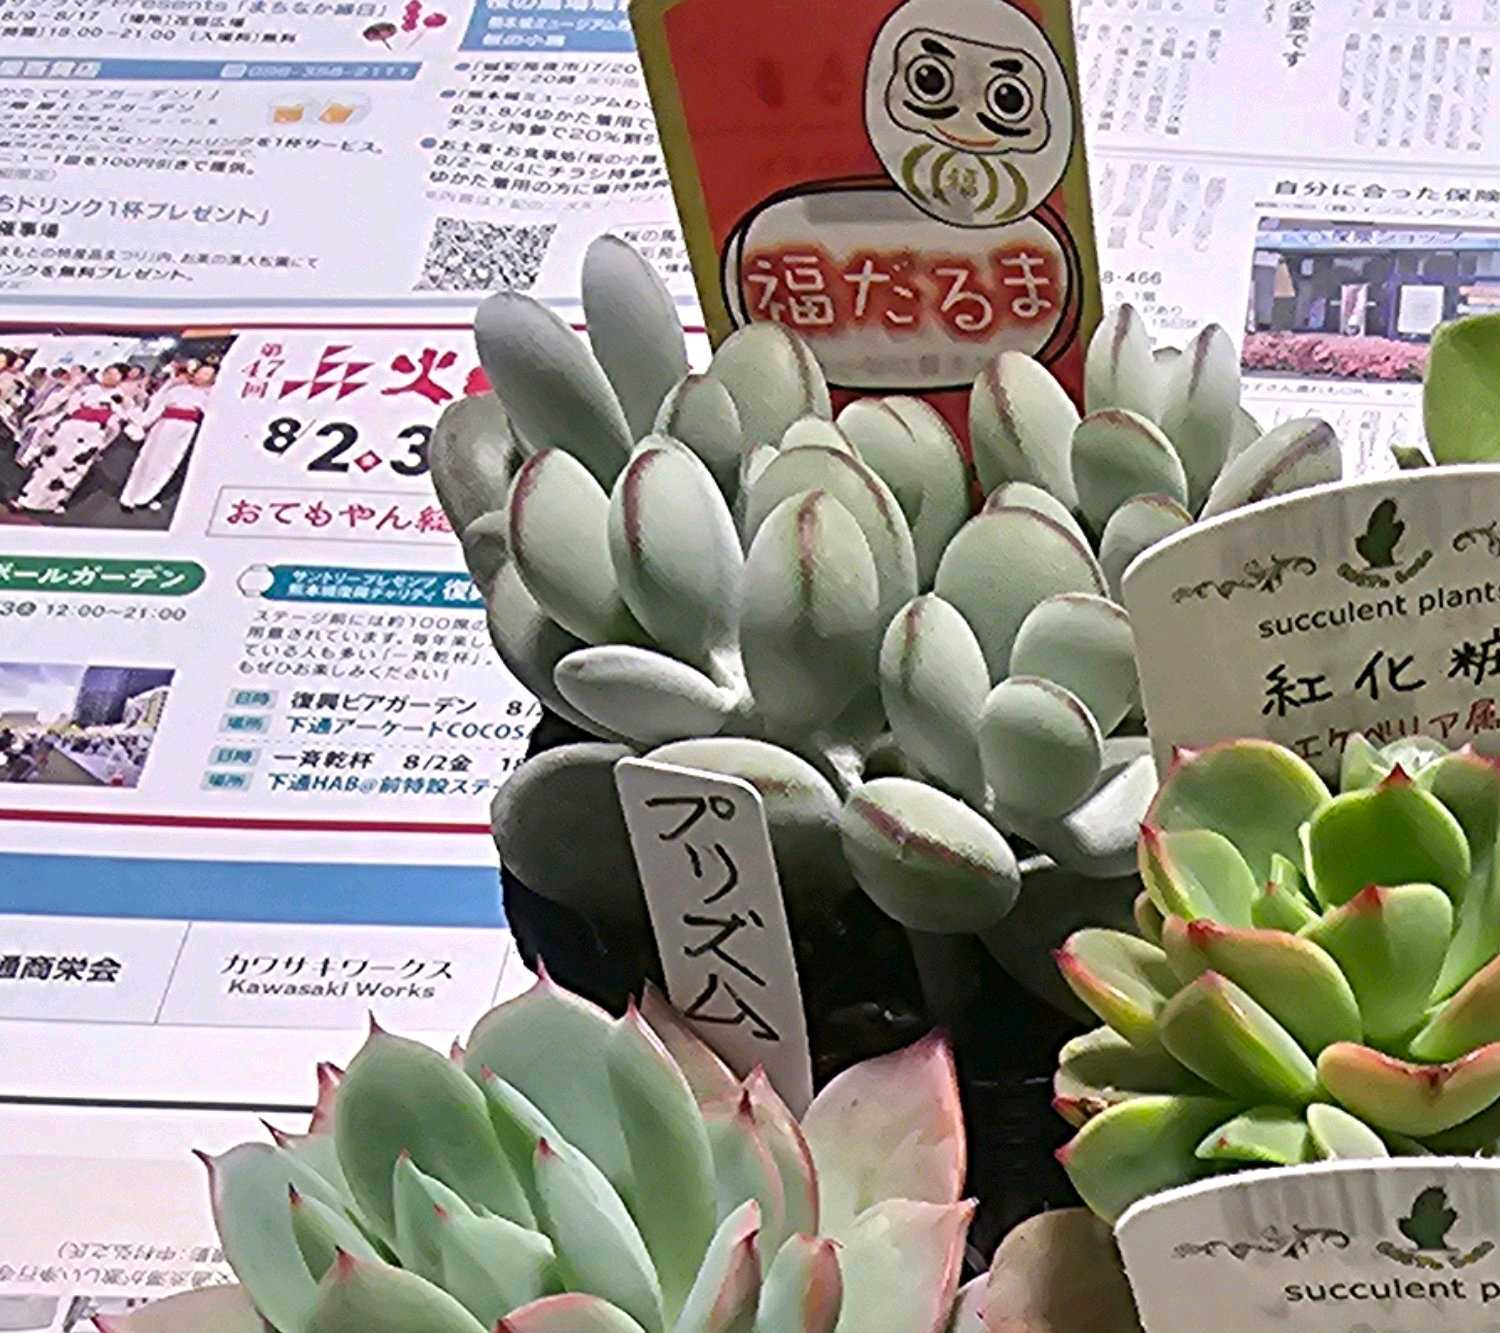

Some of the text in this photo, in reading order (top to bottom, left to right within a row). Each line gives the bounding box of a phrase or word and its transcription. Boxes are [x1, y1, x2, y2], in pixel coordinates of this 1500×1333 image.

[747, 251, 1053, 332] 福だるま
[1257, 593, 1407, 640] succulent
[644, 794, 781, 1043] プリズム
[227, 978, 436, 1000] Kawasaki Works
[1283, 1276, 1467, 1303] succulent
